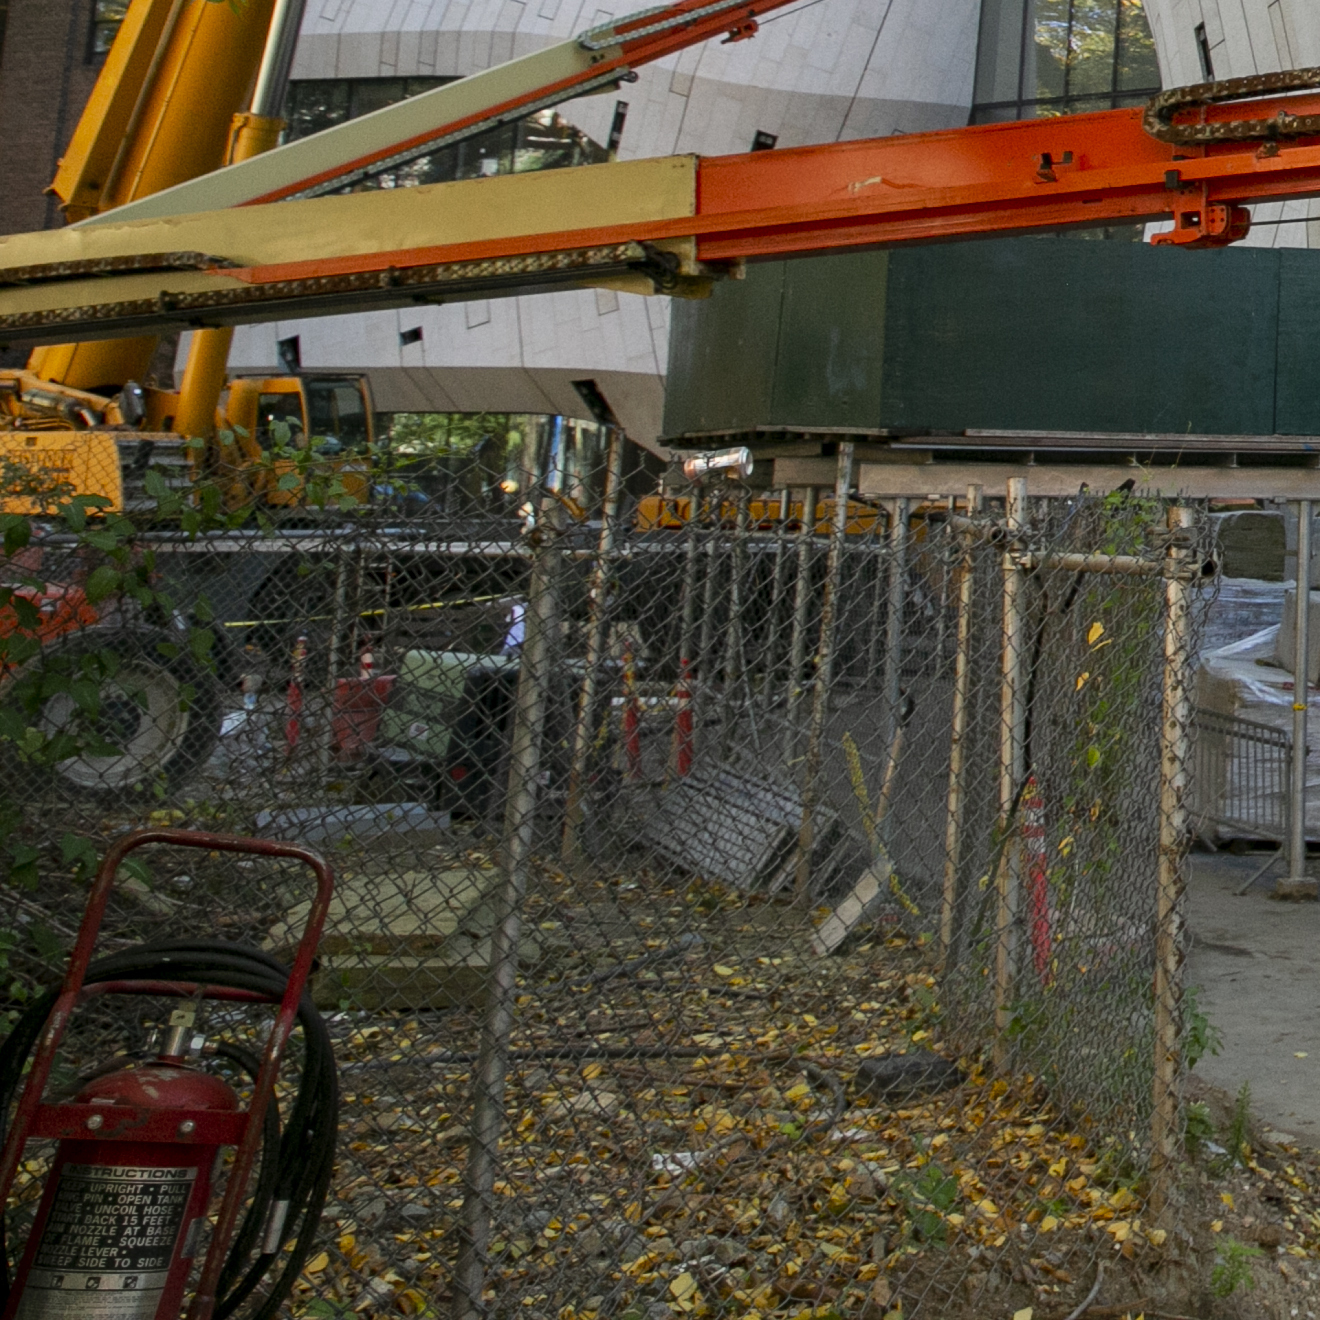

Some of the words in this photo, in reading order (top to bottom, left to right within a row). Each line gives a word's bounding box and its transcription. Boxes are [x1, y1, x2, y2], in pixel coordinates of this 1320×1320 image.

[68, 1164, 189, 1179] INSTRUCTIONS
[90, 1183, 144, 1194] UPRIGHT
[159, 1184, 187, 1194] PULL
[83, 1193, 103, 1203] PIN
[117, 1194, 151, 1205] OPEN
[156, 1195, 184, 1205] TANK
[94, 1205, 139, 1216] UNCOIL
[143, 1205, 175, 1216] HOSE
[84, 1215, 117, 1226] BACK
[122, 1216, 139, 1226] 15
[142, 1216, 171, 1226] FEET
[69, 1224, 117, 1236] NOZZLE
[123, 1226, 140, 1236] AT
[146, 1226, 177, 1236] BASE
[60, 1235, 101, 1246] FLAME
[119, 1236, 173, 1248] SQUEEZE
[81, 1246, 119, 1257] LEVER
[78, 1257, 107, 1268] SIDE
[114, 1258, 131, 1268] TO
